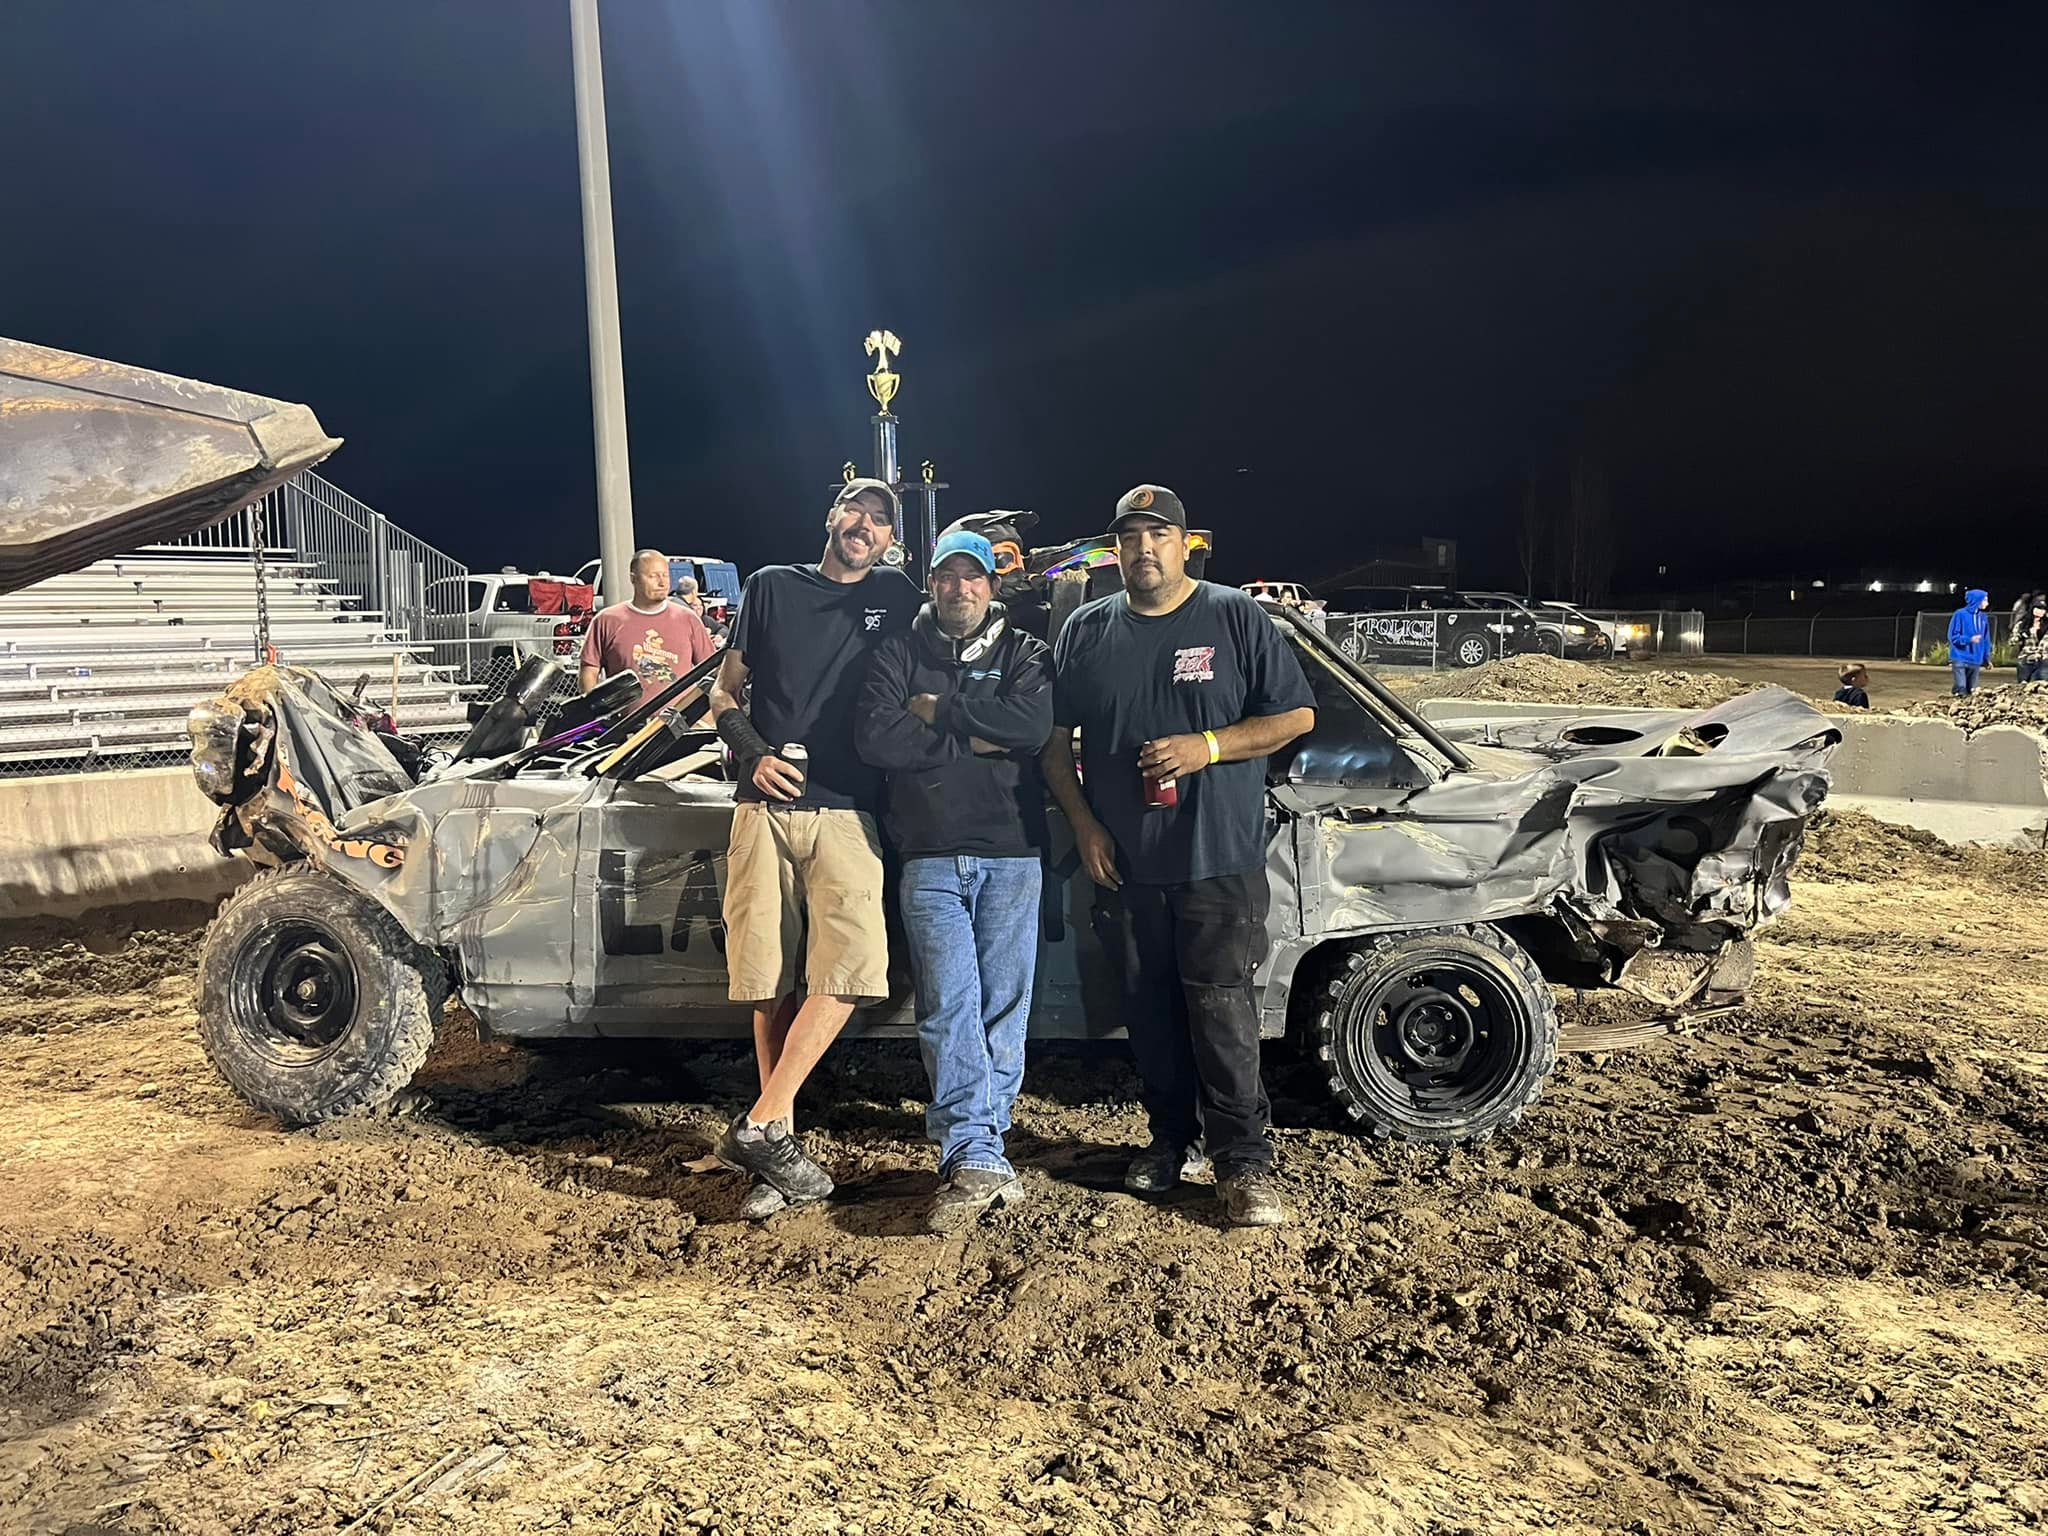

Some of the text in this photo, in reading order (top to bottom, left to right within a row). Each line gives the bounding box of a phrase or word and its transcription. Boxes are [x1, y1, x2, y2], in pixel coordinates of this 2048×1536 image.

[865, 615, 881, 631] 95
[1366, 618, 1434, 639] POLICE
[960, 617, 1006, 662] EVS
